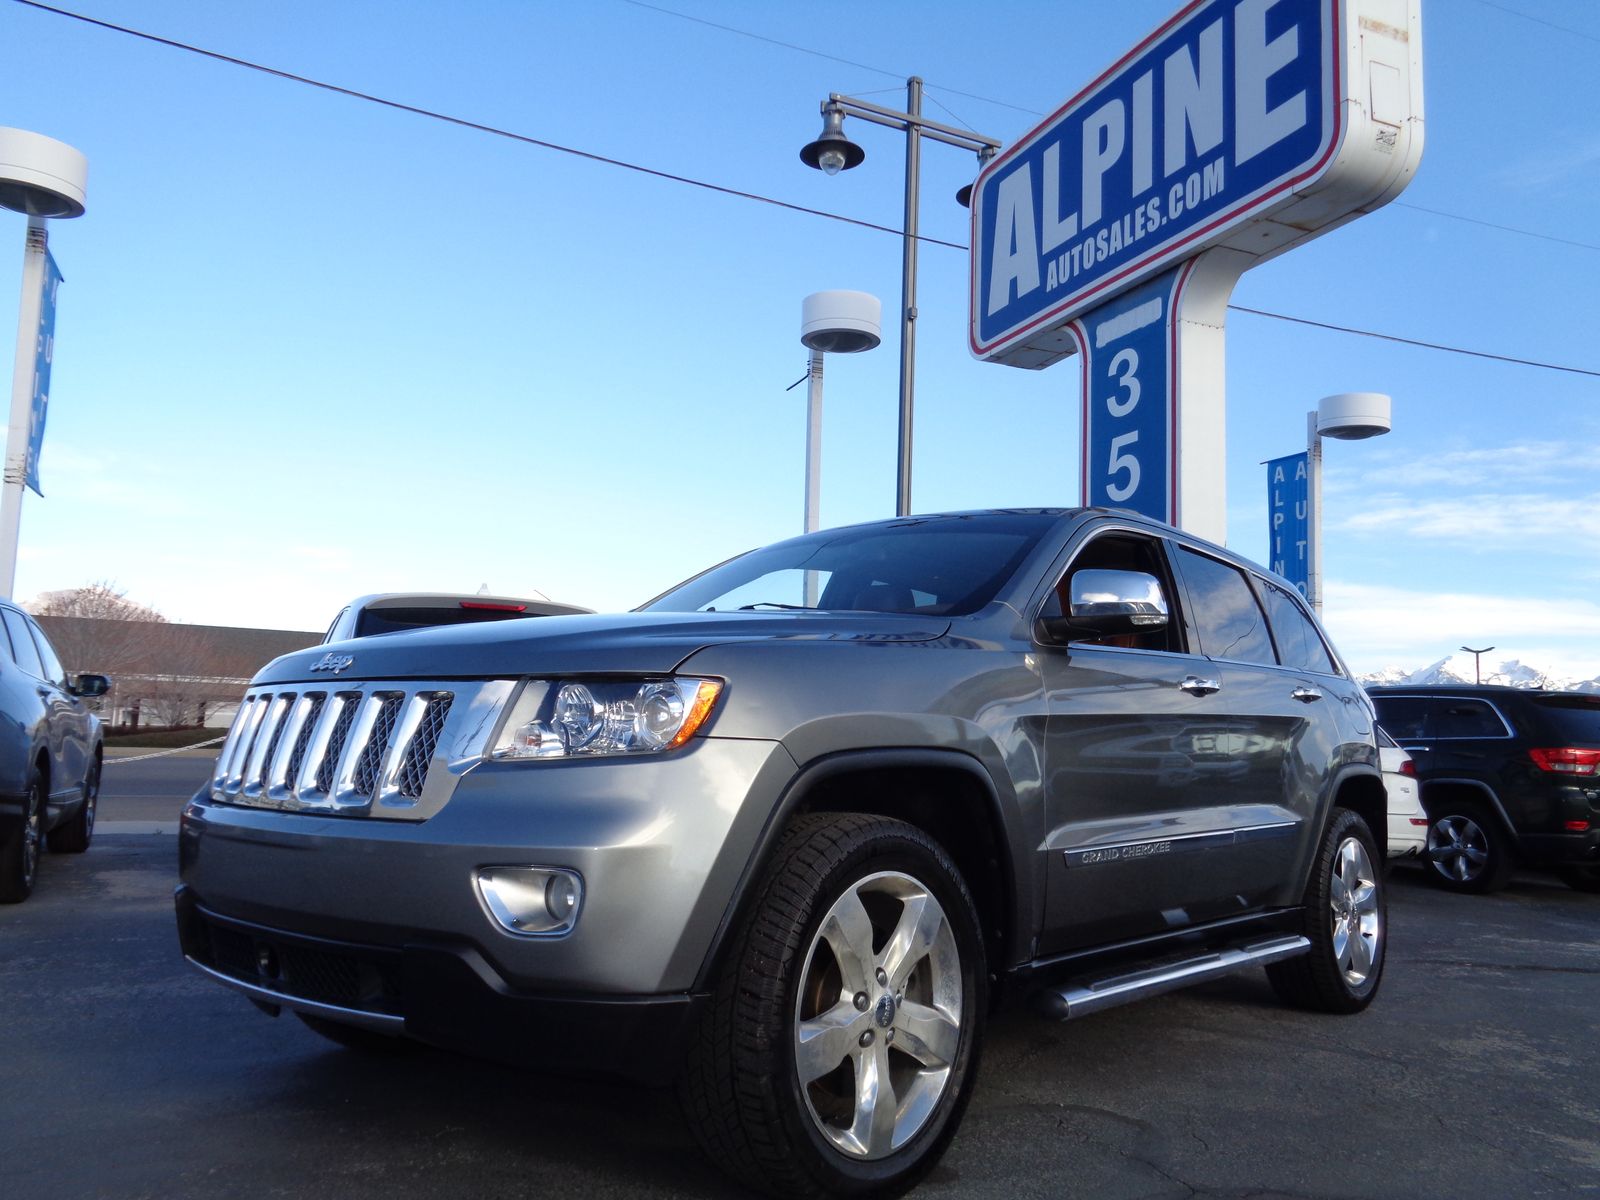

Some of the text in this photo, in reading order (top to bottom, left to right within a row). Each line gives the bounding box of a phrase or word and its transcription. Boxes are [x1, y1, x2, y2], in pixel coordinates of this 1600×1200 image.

[987, 0, 1307, 317] ALPINE
[1046, 156, 1225, 293] AUTOSALES.COM
[309, 652, 354, 675] Jeep
[1081, 841, 1171, 864] GRAND CHEROKEE
